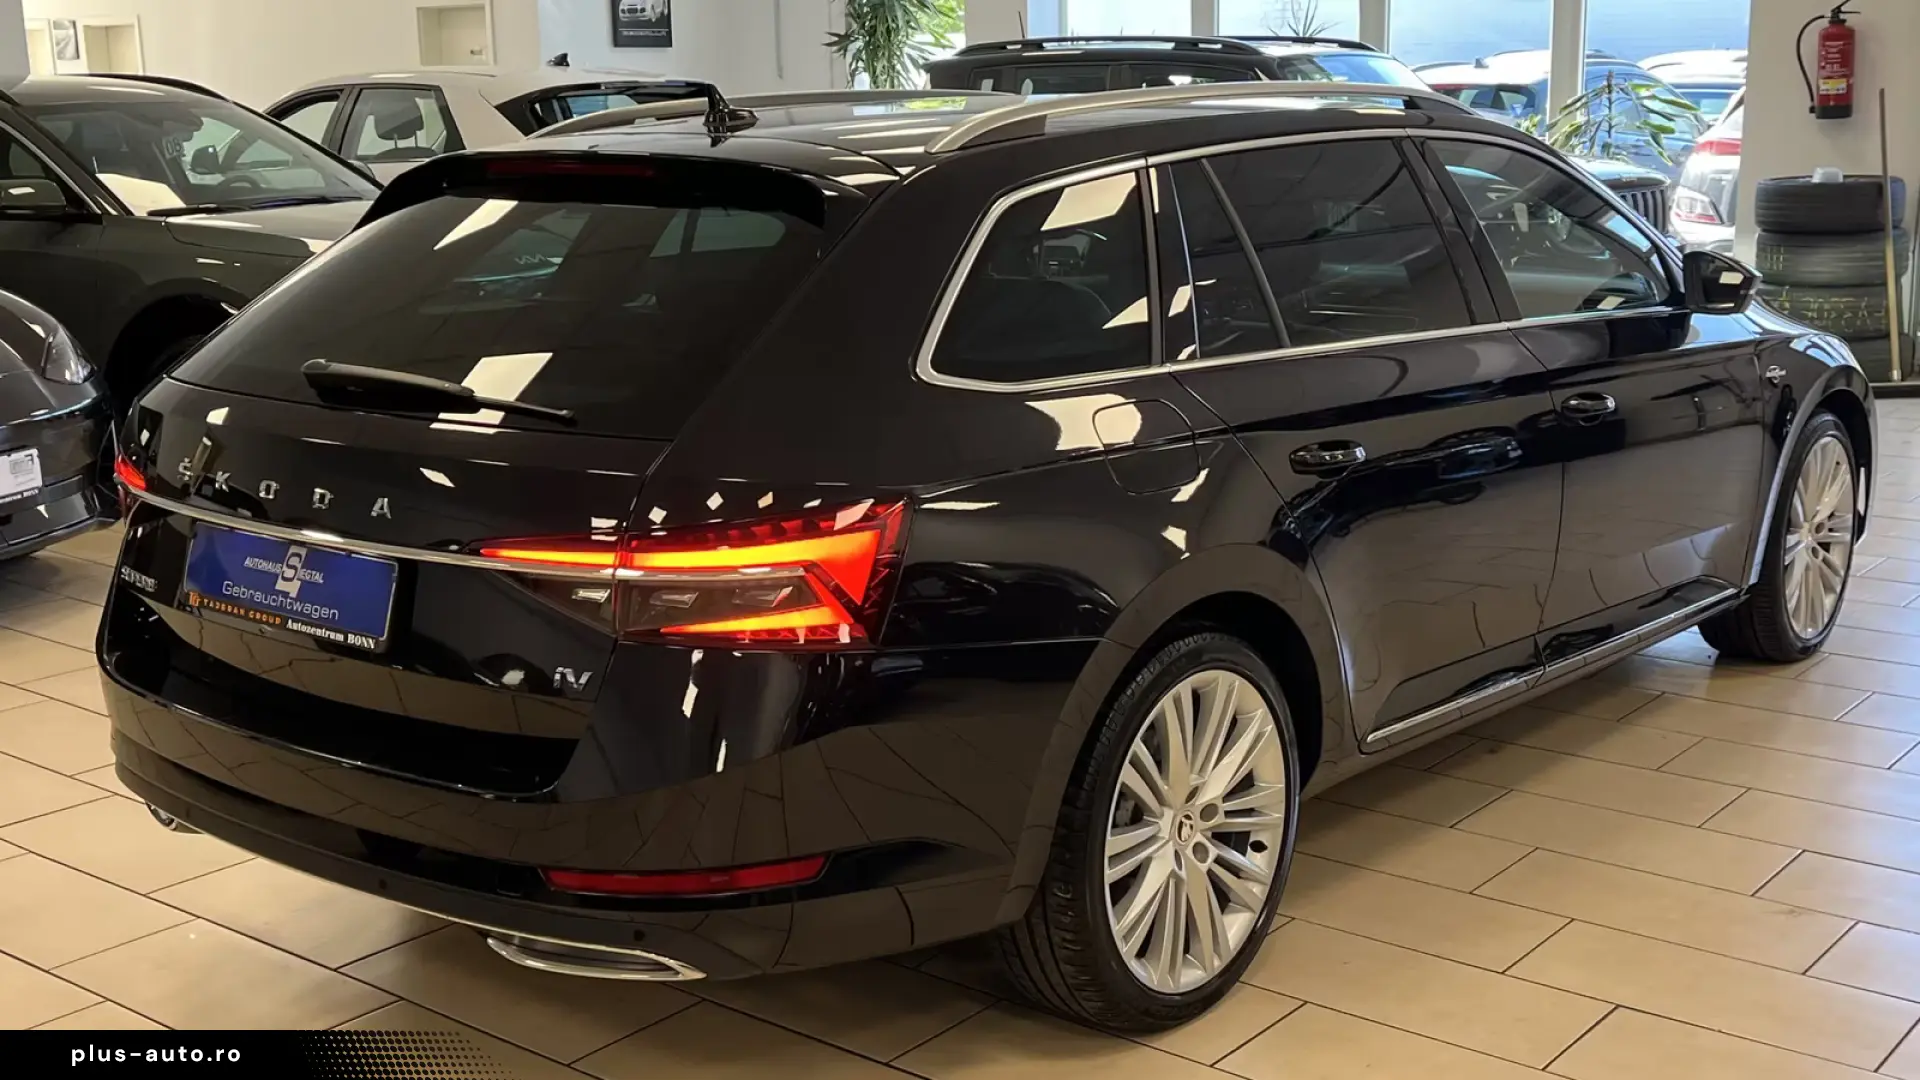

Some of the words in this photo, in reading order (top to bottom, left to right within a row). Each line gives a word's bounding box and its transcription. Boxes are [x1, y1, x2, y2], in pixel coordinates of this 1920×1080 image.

[244, 556, 283, 574] AUTOHAUS
[222, 580, 339, 621] Gebrauchtwagen
[248, 610, 282, 625] GROUP
[285, 618, 345, 643] Autozentrum
[347, 632, 377, 650] BONN
